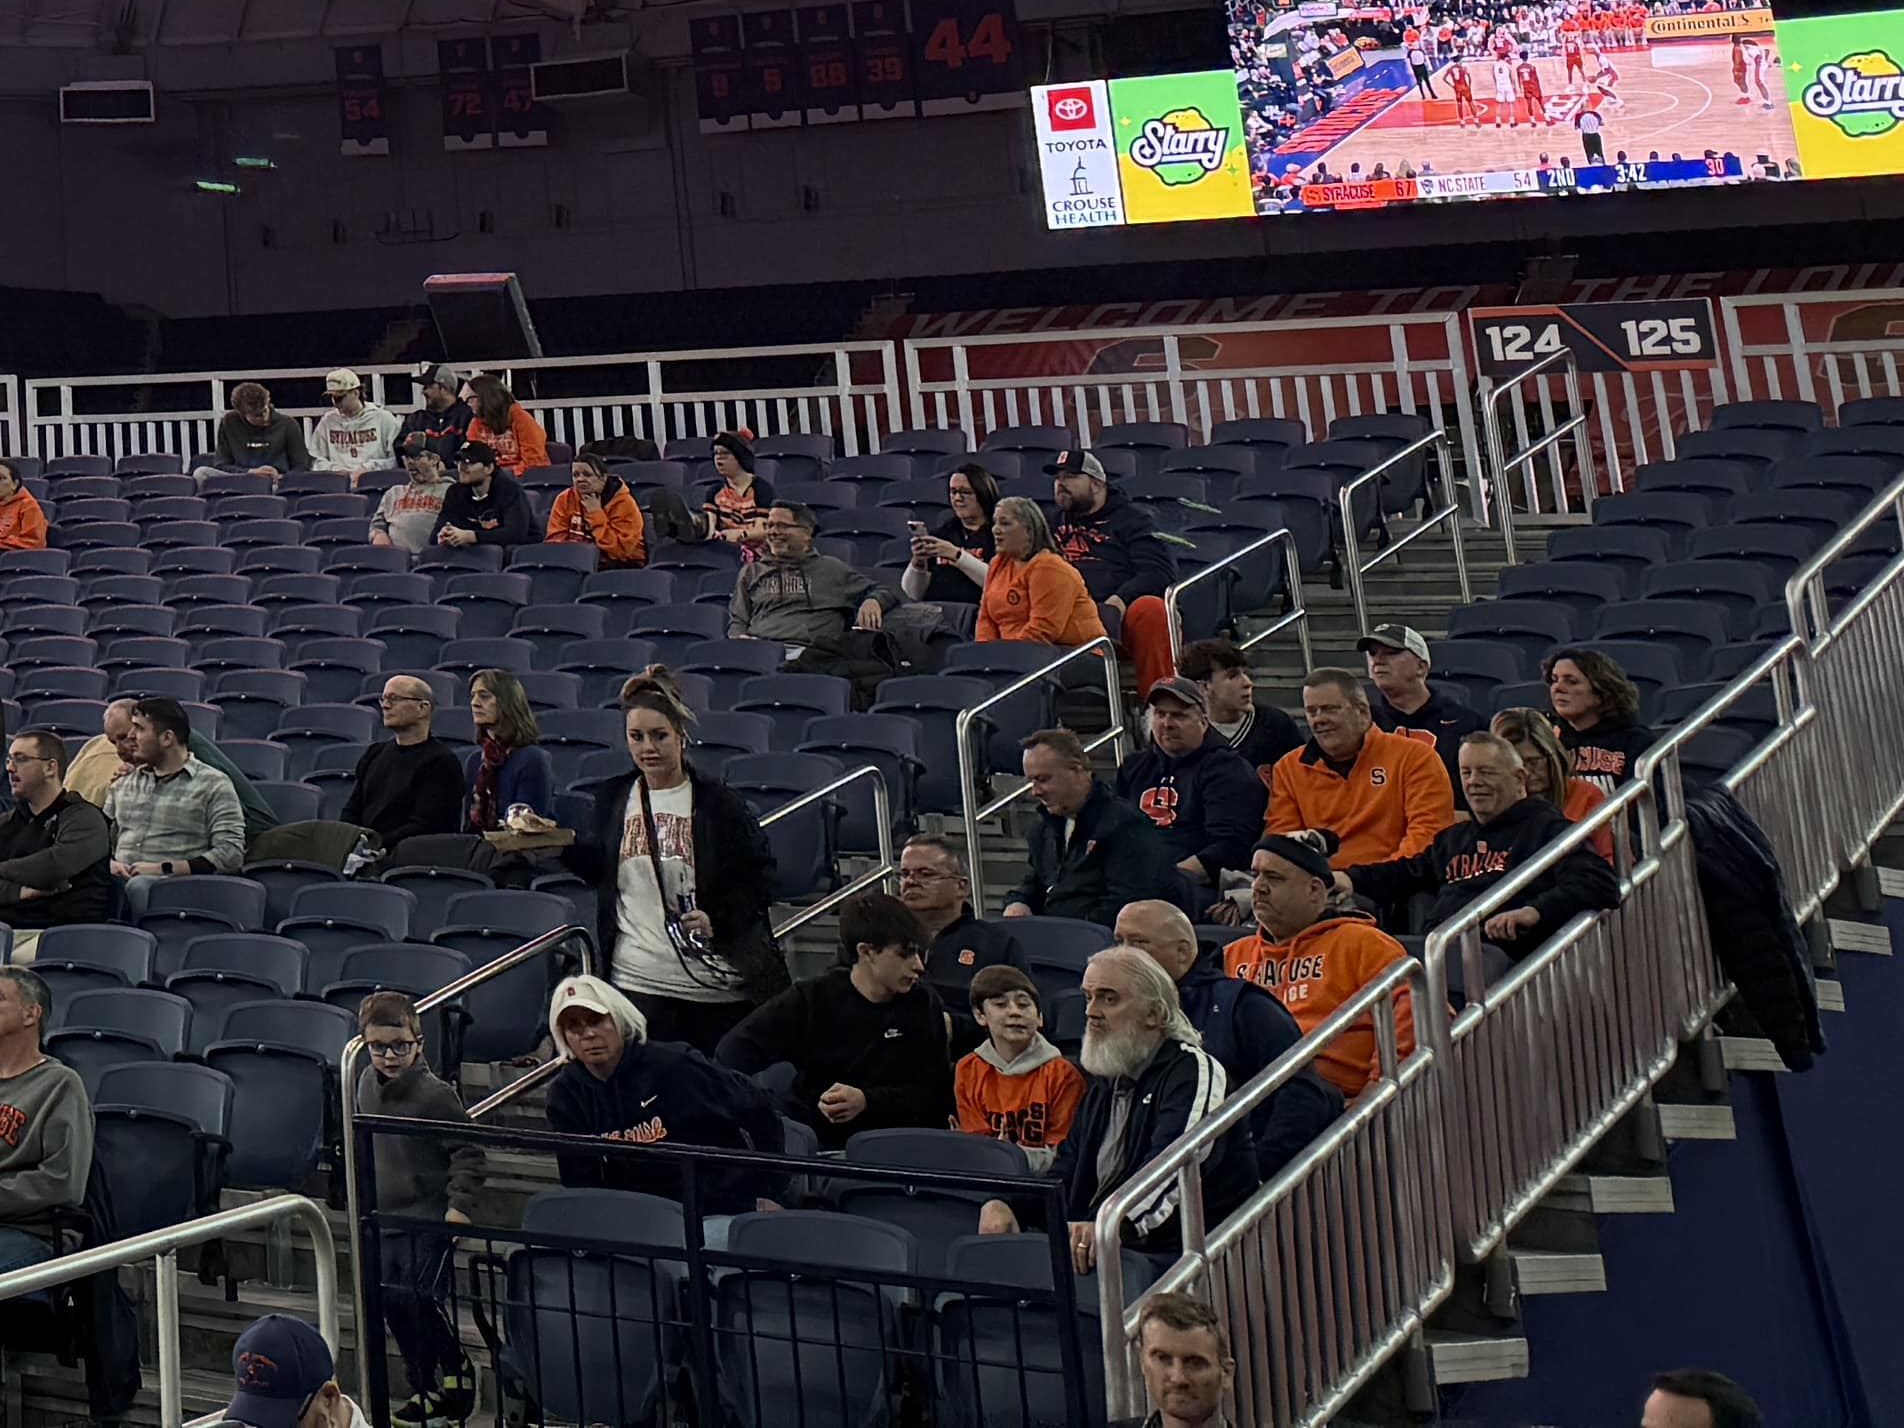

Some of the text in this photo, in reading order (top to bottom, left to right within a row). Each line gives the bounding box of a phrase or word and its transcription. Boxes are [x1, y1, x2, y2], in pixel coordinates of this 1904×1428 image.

[923, 14, 1011, 68] 44
[1046, 139, 1107, 153] TOYOTA
[1129, 119, 1230, 171] Starry
[1322, 158, 1725, 201] SYRACUSE 67 NC STATE 54 2ND 3:42 30
[1053, 197, 1115, 212] CROUSE
[1056, 210, 1117, 225] HEALTH
[906, 294, 1314, 337] WELCOME
[1485, 317, 1701, 362] 124 125
[1371, 768, 1385, 785] S
